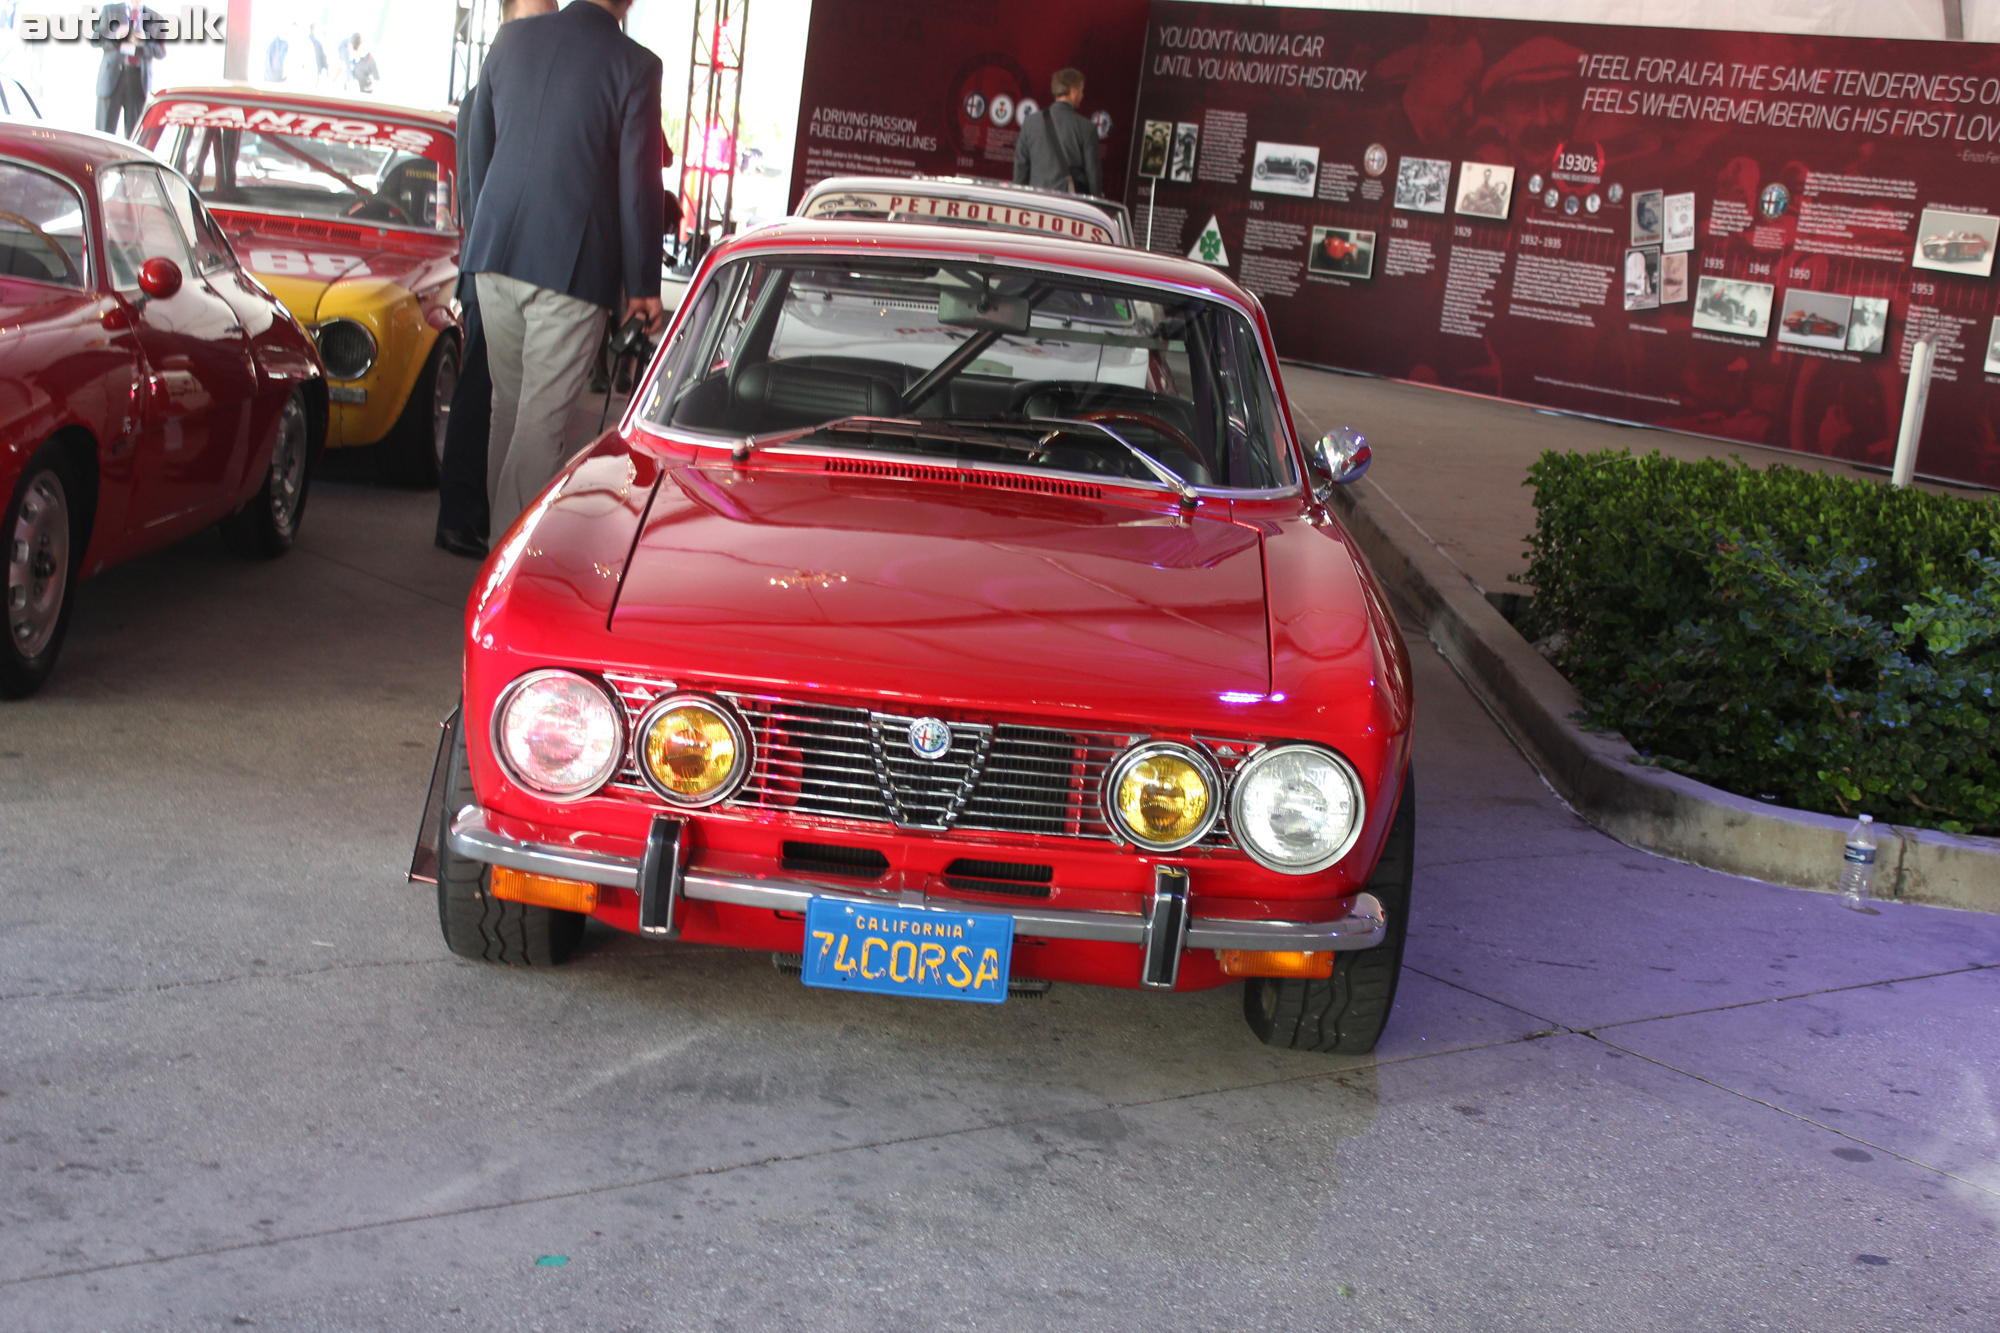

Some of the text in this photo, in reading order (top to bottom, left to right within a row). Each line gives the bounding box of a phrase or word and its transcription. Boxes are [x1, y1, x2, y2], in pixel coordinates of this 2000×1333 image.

[1158, 27, 1325, 59] YOU DON'T KNOW A CAR
[1153, 55, 1368, 92] UNTIL YOU KNOW ITS HISTORY.
[1587, 55, 1631, 81] FEEL
[1635, 58, 1677, 84] FOR
[1676, 60, 1726, 88] ALFA
[1729, 63, 1769, 91] THE
[1771, 66, 1830, 95] SAME
[1833, 70, 1977, 105] TENDERNESS
[165, 102, 434, 148] SANTO'S
[813, 107, 917, 134] A DRIVING PASSION
[1582, 87, 2000, 143] FEELS WHEN REMEMBERING HIS FIRST LOV
[809, 122, 937, 151] FUELED AT FINISH LINES
[889, 196, 1103, 243] PETROLICIOUS
[1704, 257, 1725, 270] 1935
[1749, 262, 1771, 276] 1946
[1788, 267, 1811, 281] 1950
[1911, 282, 1935, 296] 1953
[855, 915, 964, 939] CALIFORNIA
[812, 930, 1000, 992] 74CORSA
